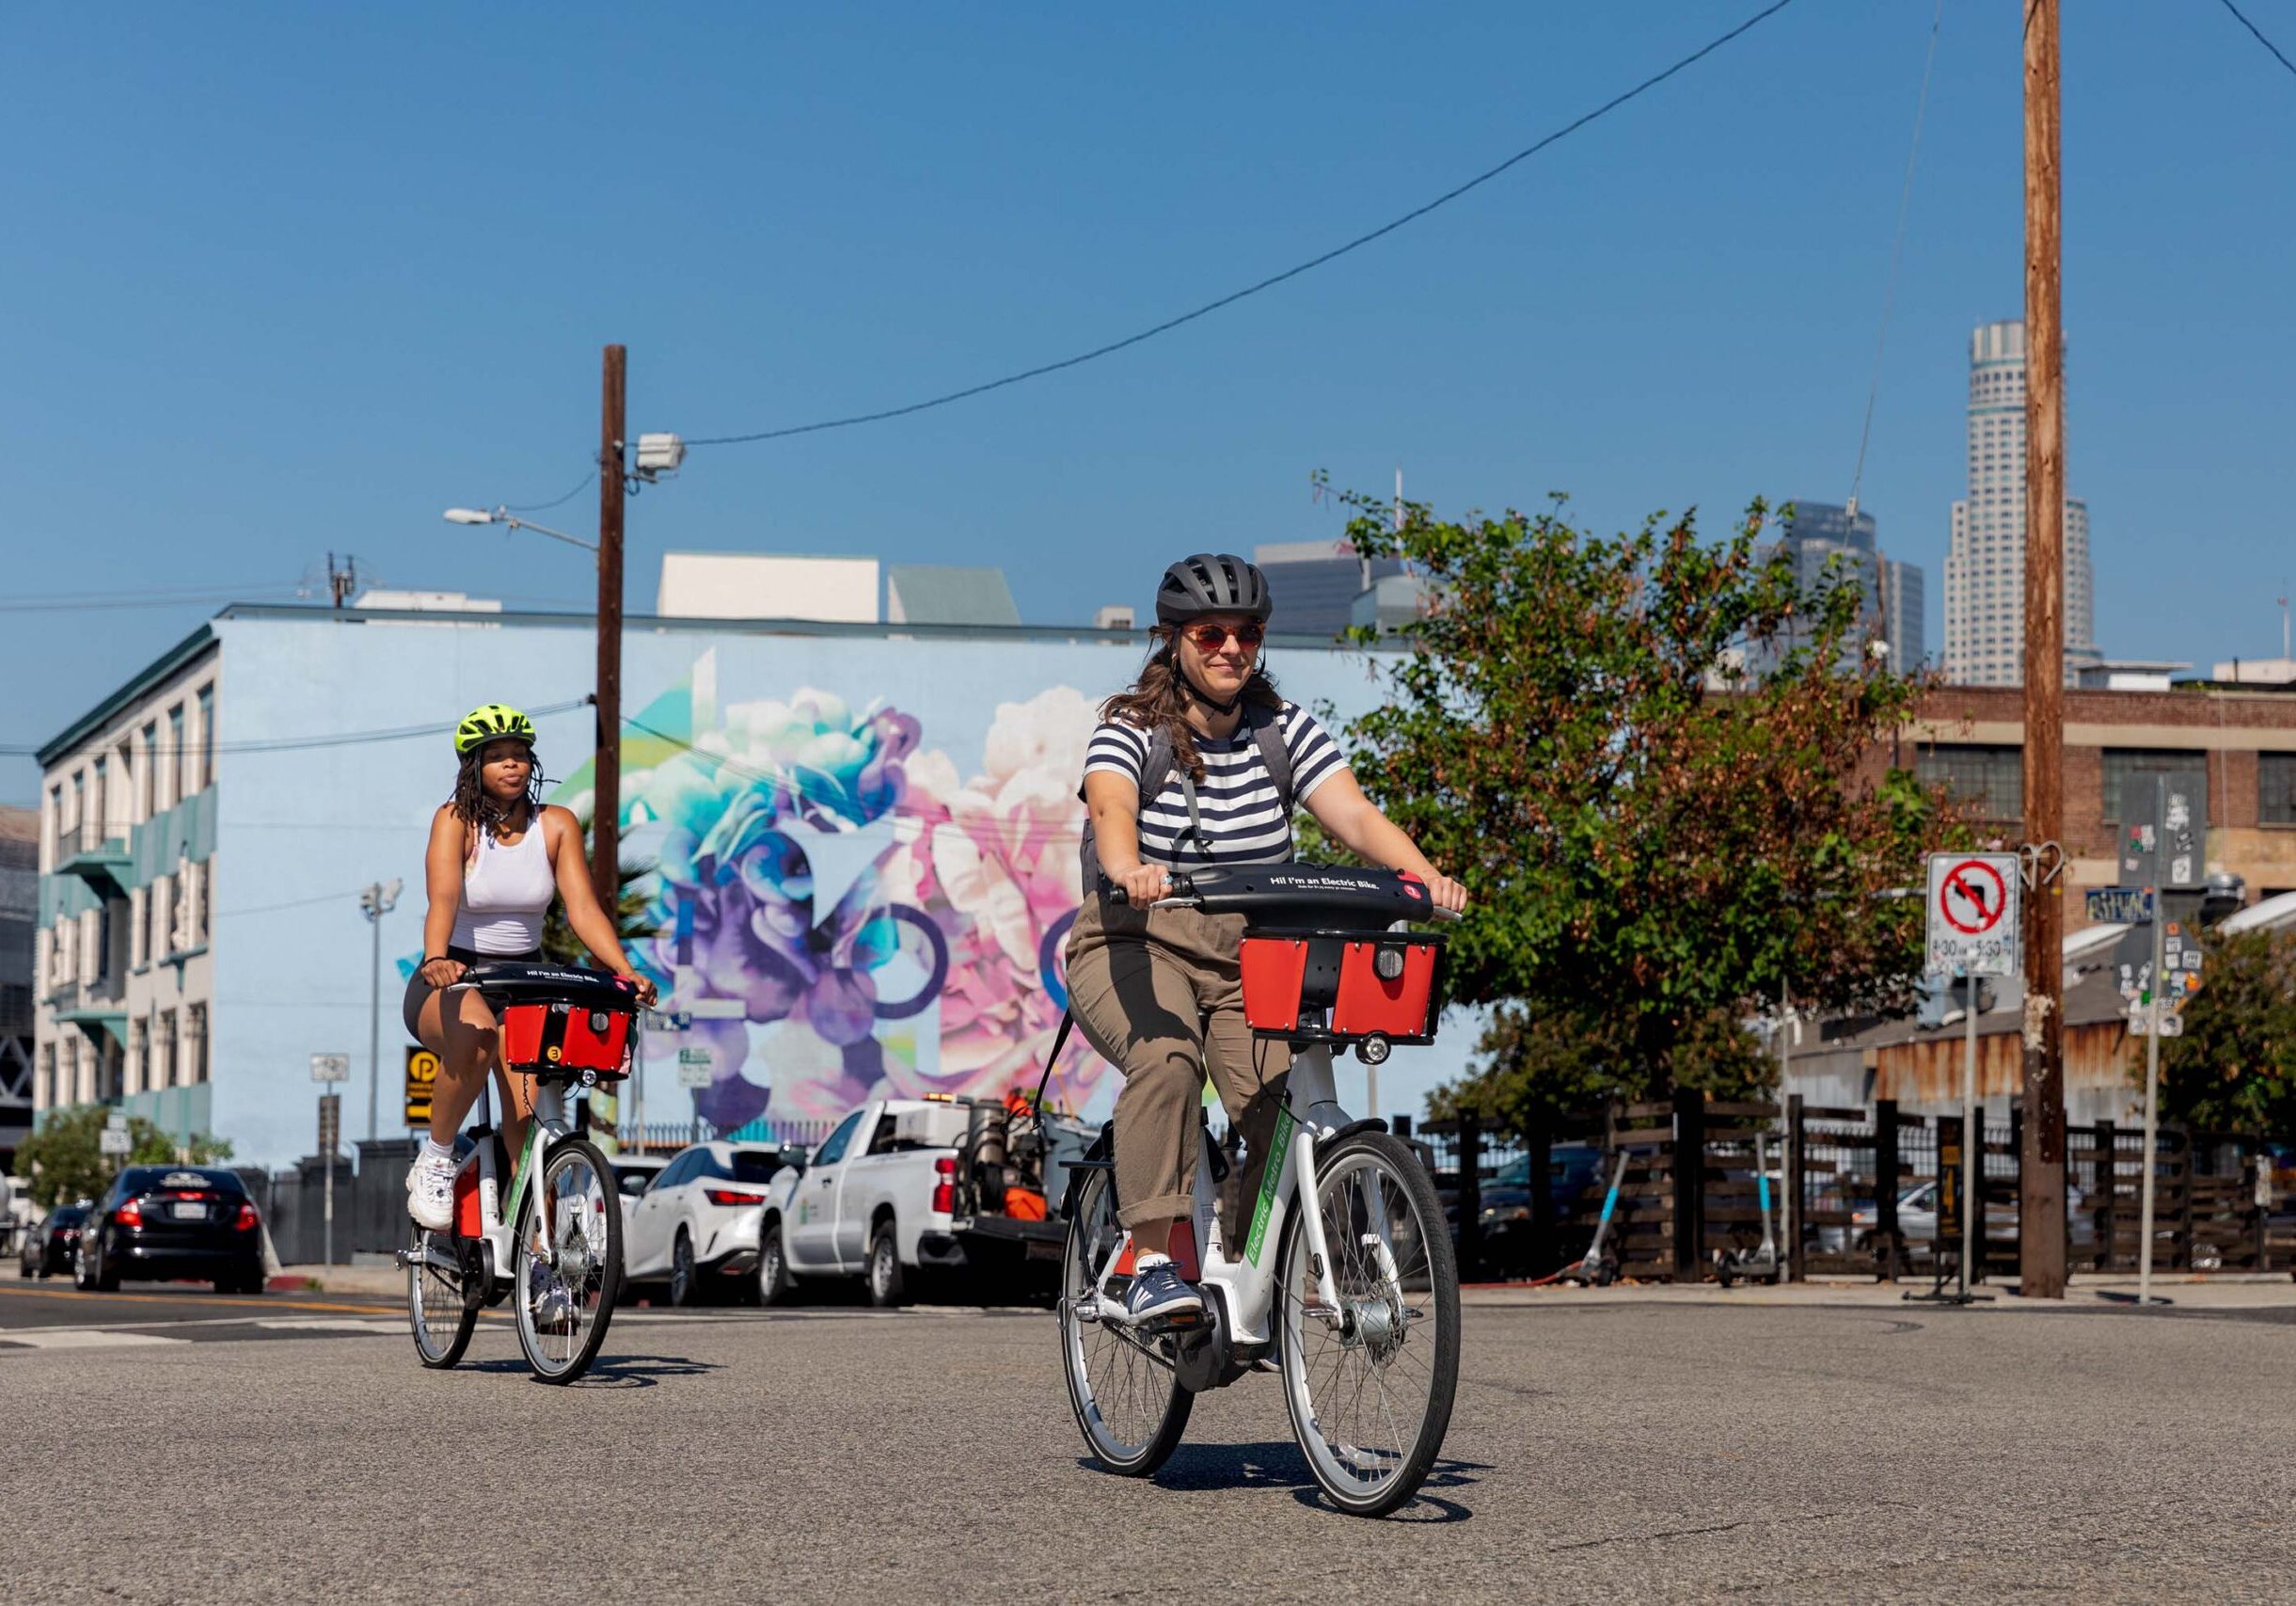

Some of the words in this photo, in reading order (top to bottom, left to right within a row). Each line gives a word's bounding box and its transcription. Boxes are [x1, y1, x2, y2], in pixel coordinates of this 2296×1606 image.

[1321, 877, 1356, 887] Electric
[1357, 880, 1380, 890] Bike.
[1247, 1201, 1270, 1263] Electric
[1263, 1151, 1282, 1201] Metro
[1277, 1113, 1292, 1149] Bike
